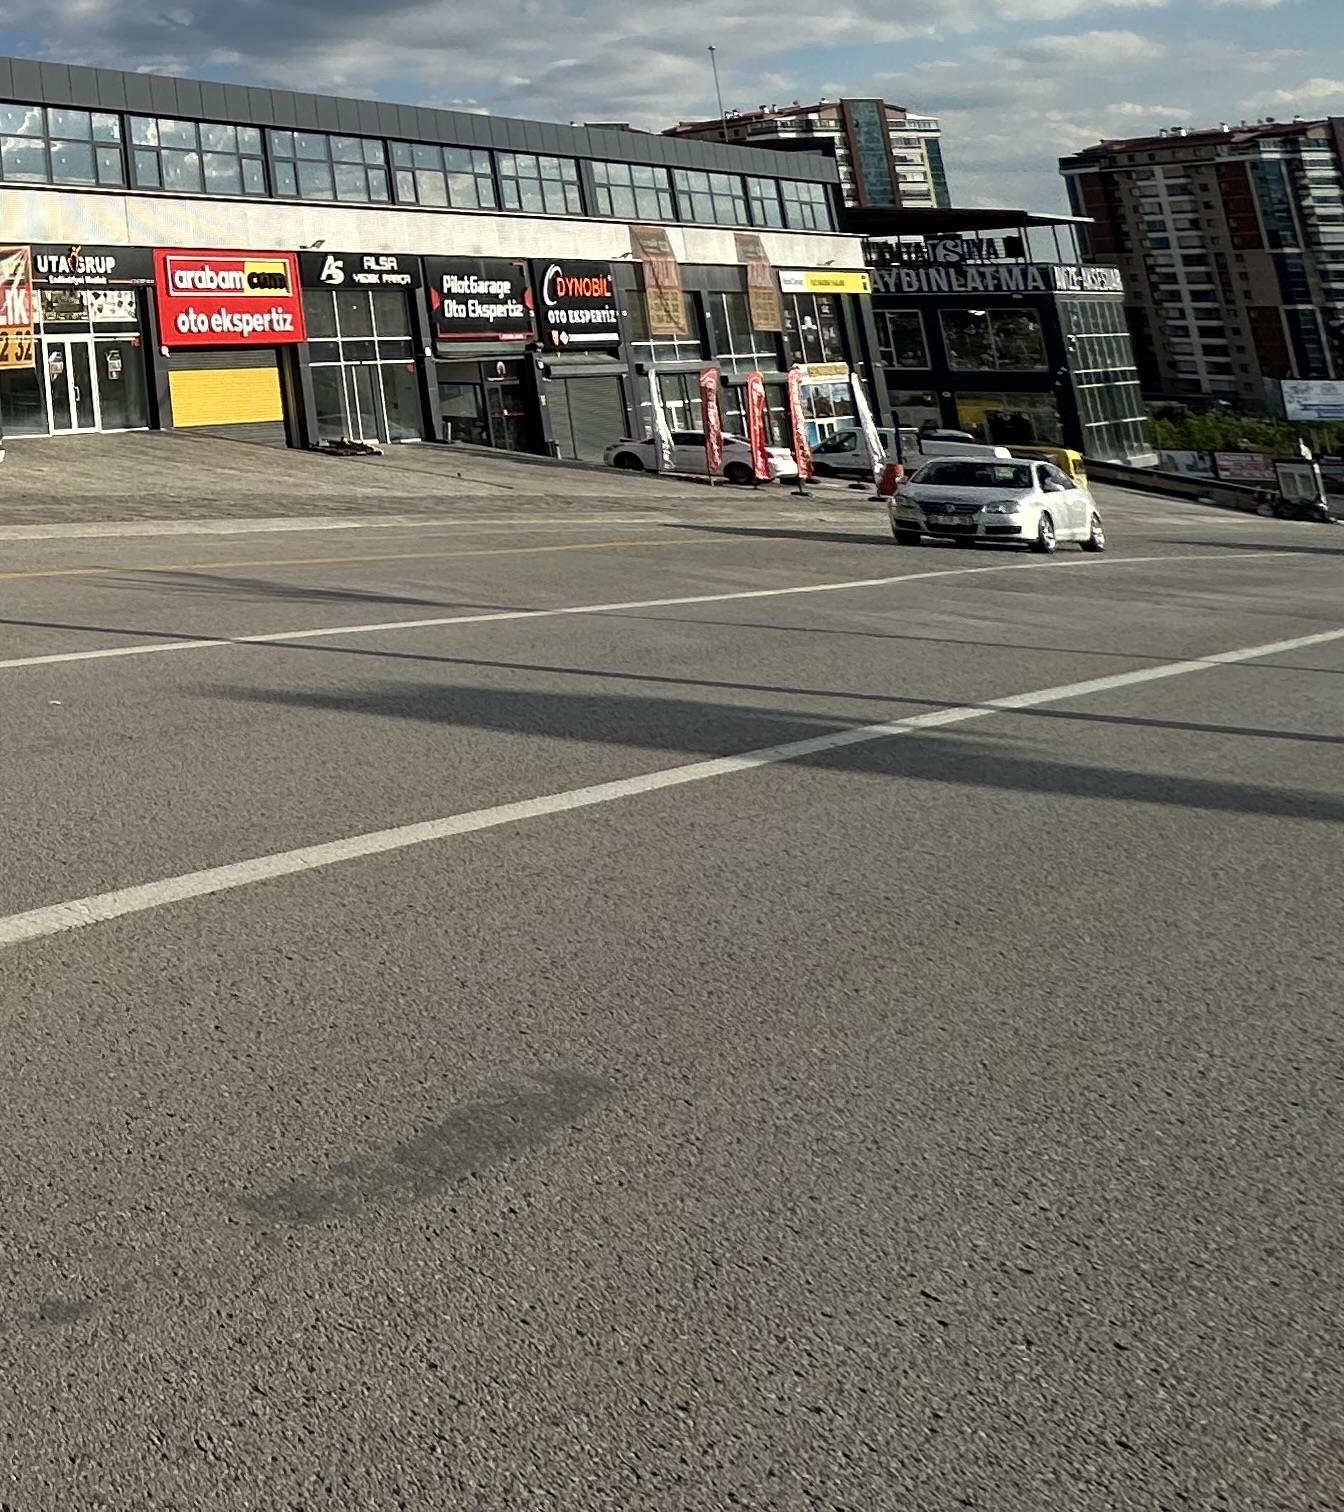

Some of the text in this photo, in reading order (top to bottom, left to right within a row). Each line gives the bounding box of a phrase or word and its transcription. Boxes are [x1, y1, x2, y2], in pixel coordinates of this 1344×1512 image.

[36, 255, 70, 273] UTA
[76, 256, 117, 274] GRUP
[363, 256, 399, 271] ALSA
[174, 264, 244, 289] arabam
[442, 274, 512, 299] PilotGarage
[556, 273, 612, 297] DYNOBİL
[176, 306, 294, 337] oto ekspertiz
[444, 299, 524, 323] Oto Ekspertiz
[547, 304, 617, 324] OTO EKSPERTİZ
[14, 330, 32, 362] 32
